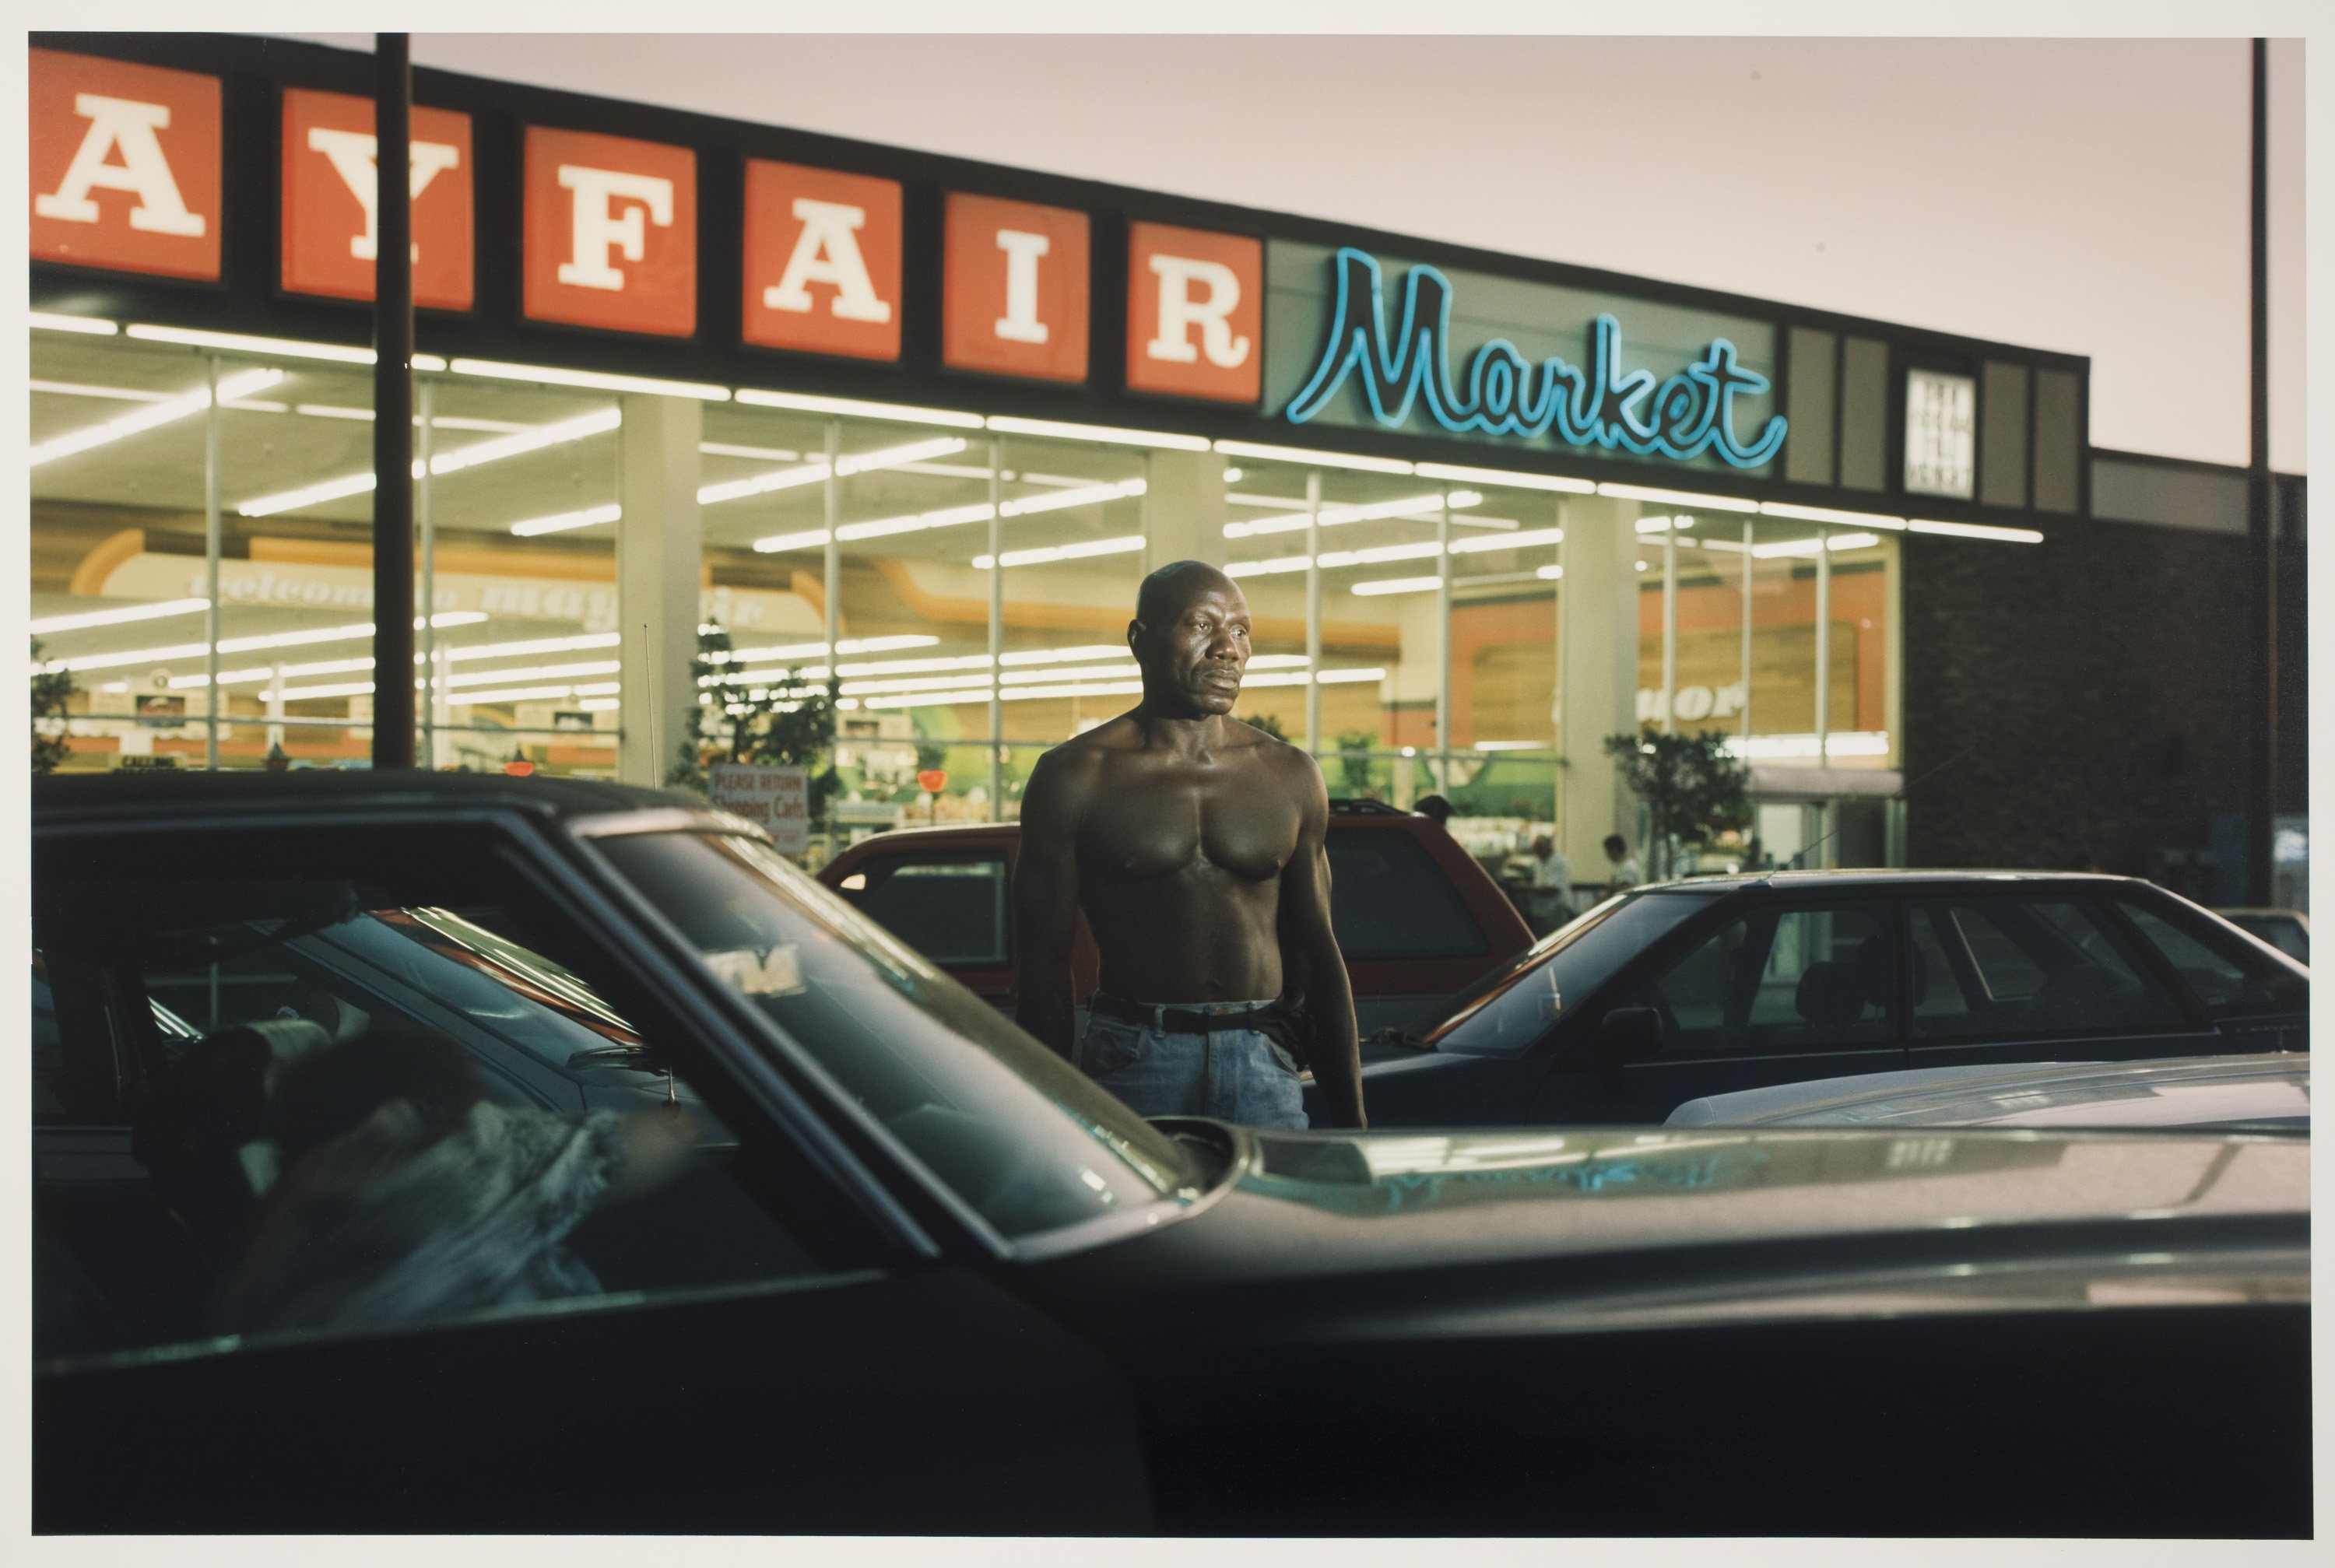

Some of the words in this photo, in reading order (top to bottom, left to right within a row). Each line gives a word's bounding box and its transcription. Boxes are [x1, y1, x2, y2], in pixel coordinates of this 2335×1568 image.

[35, 92, 1250, 368] AYFAIR
[1286, 246, 1789, 468] Market
[189, 572, 375, 609] welcom
[479, 587, 764, 632] mayir
